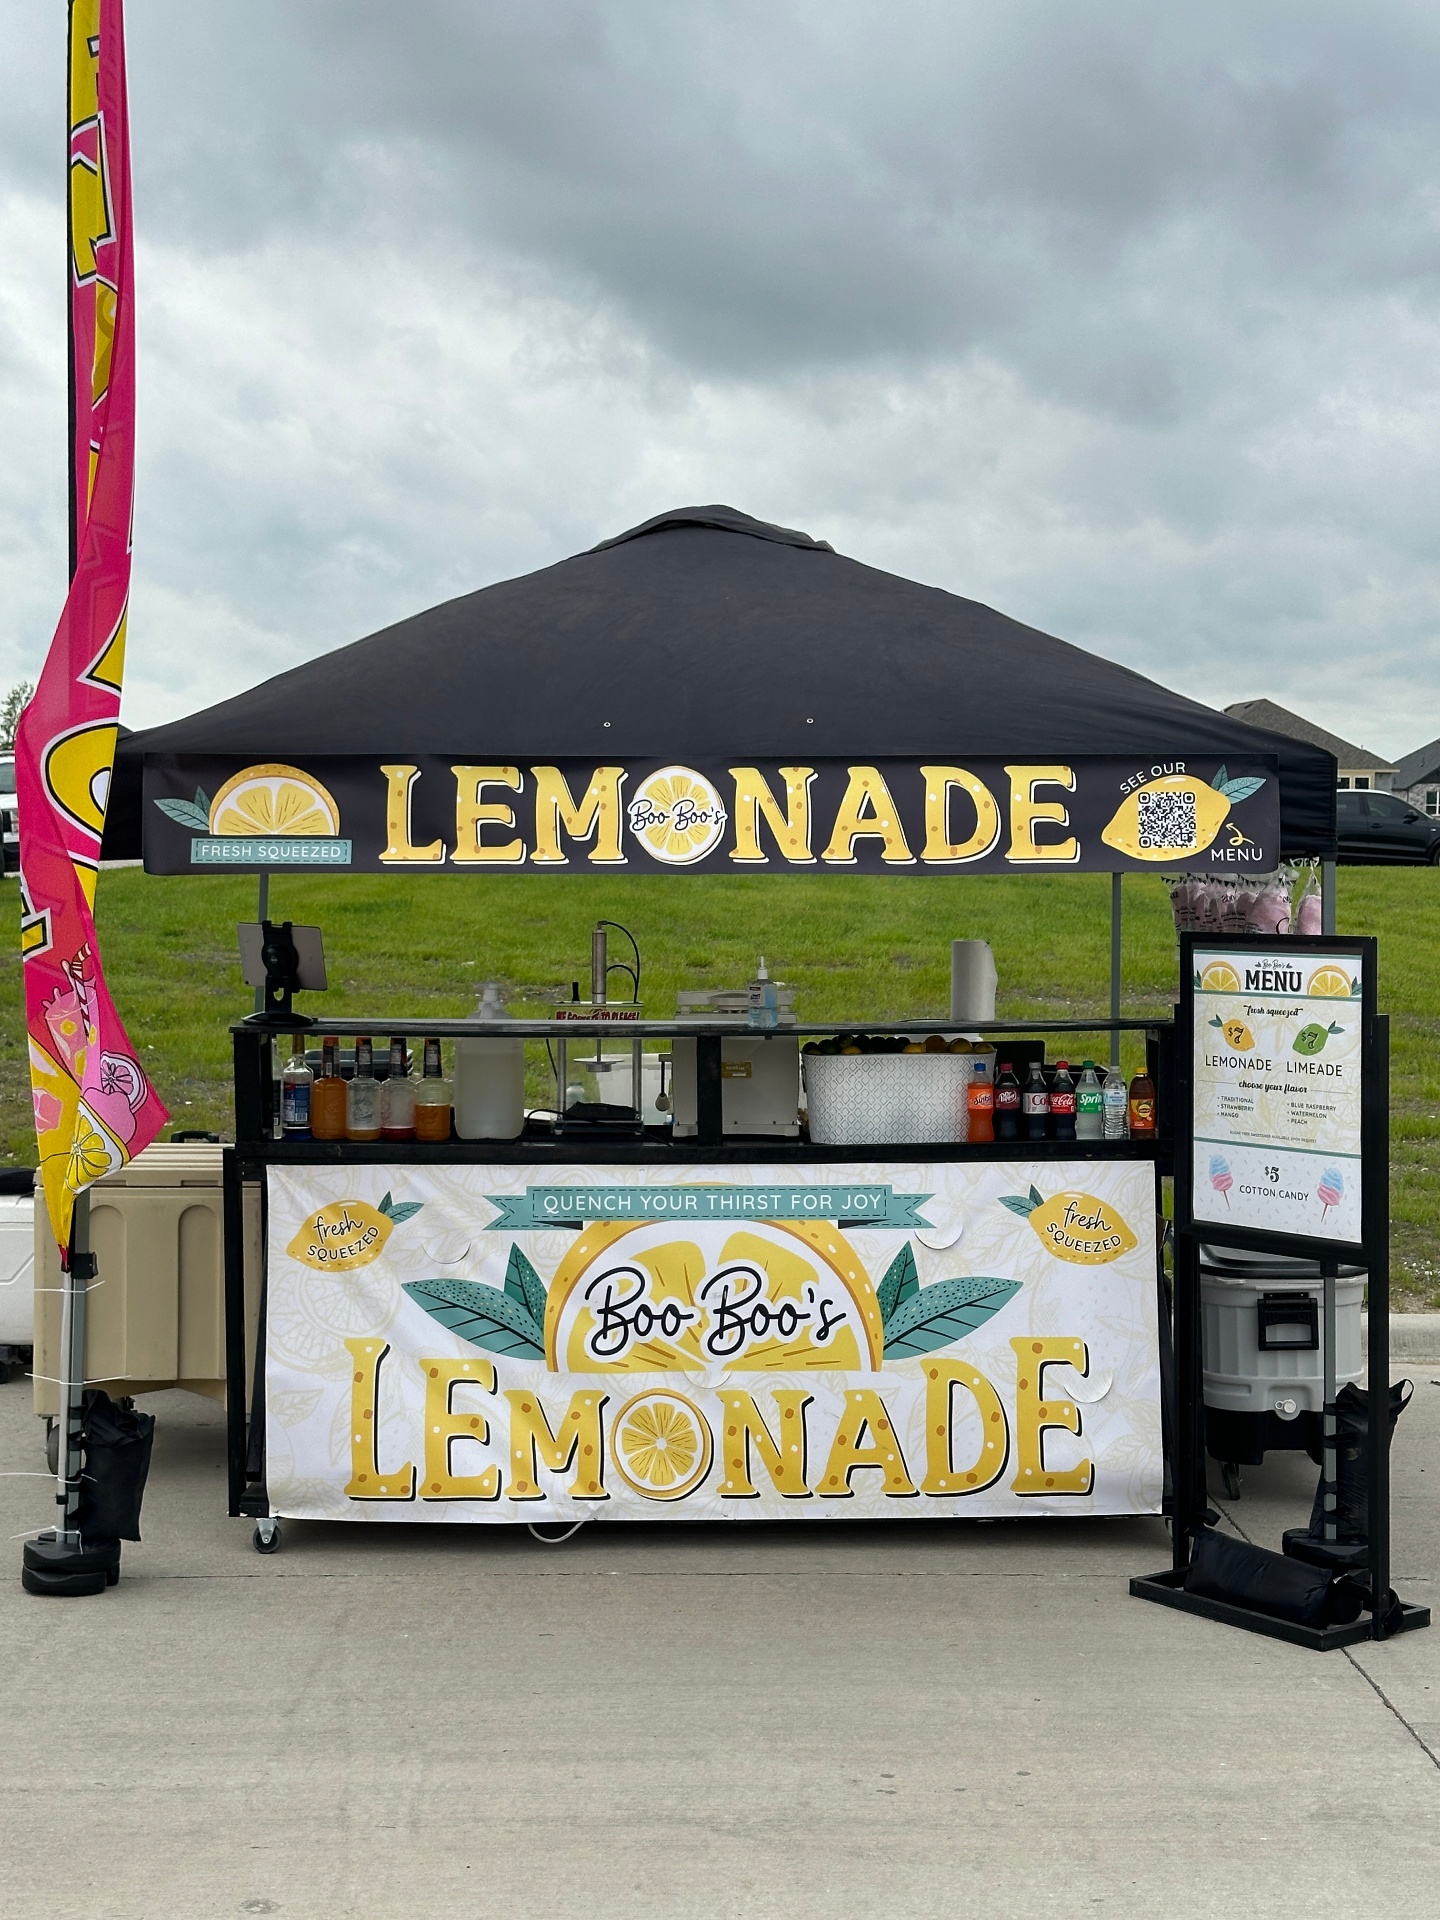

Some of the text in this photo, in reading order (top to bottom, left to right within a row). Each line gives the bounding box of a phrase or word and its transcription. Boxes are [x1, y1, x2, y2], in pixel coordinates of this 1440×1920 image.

[1120, 762, 1186, 794] SEE OUR
[629, 799, 725, 831] Boo Boo's
[201, 845, 341, 859] FRESH SQUEEZED
[1211, 848, 1263, 862] MENU
[1245, 969, 1303, 992] MENU
[1227, 1026, 1245, 1046] $7
[1301, 1031, 1319, 1050] $7
[1205, 1055, 1272, 1071] LEMONADE
[1286, 1061, 1343, 1077] LIMEADE
[1238, 1080, 1308, 1094] choose your flavor
[1221, 1103, 1254, 1111] STRAWBERRY
[1291, 1110, 1327, 1119] WATERMELON
[1305, 1103, 1336, 1111] RASPBERRY
[1264, 1166, 1280, 1183] $5
[1239, 1185, 1309, 1201] COTTON CANDY
[543, 1194, 881, 1213] QUENCH YOUR THIRST FOR JOY
[1063, 1201, 1112, 1232] fresh
[313, 1210, 363, 1245] fresh
[307, 1225, 380, 1262] SQUEEZED
[1046, 1222, 1122, 1253] SQUEEZED
[584, 1266, 847, 1357] Boo Boo's
